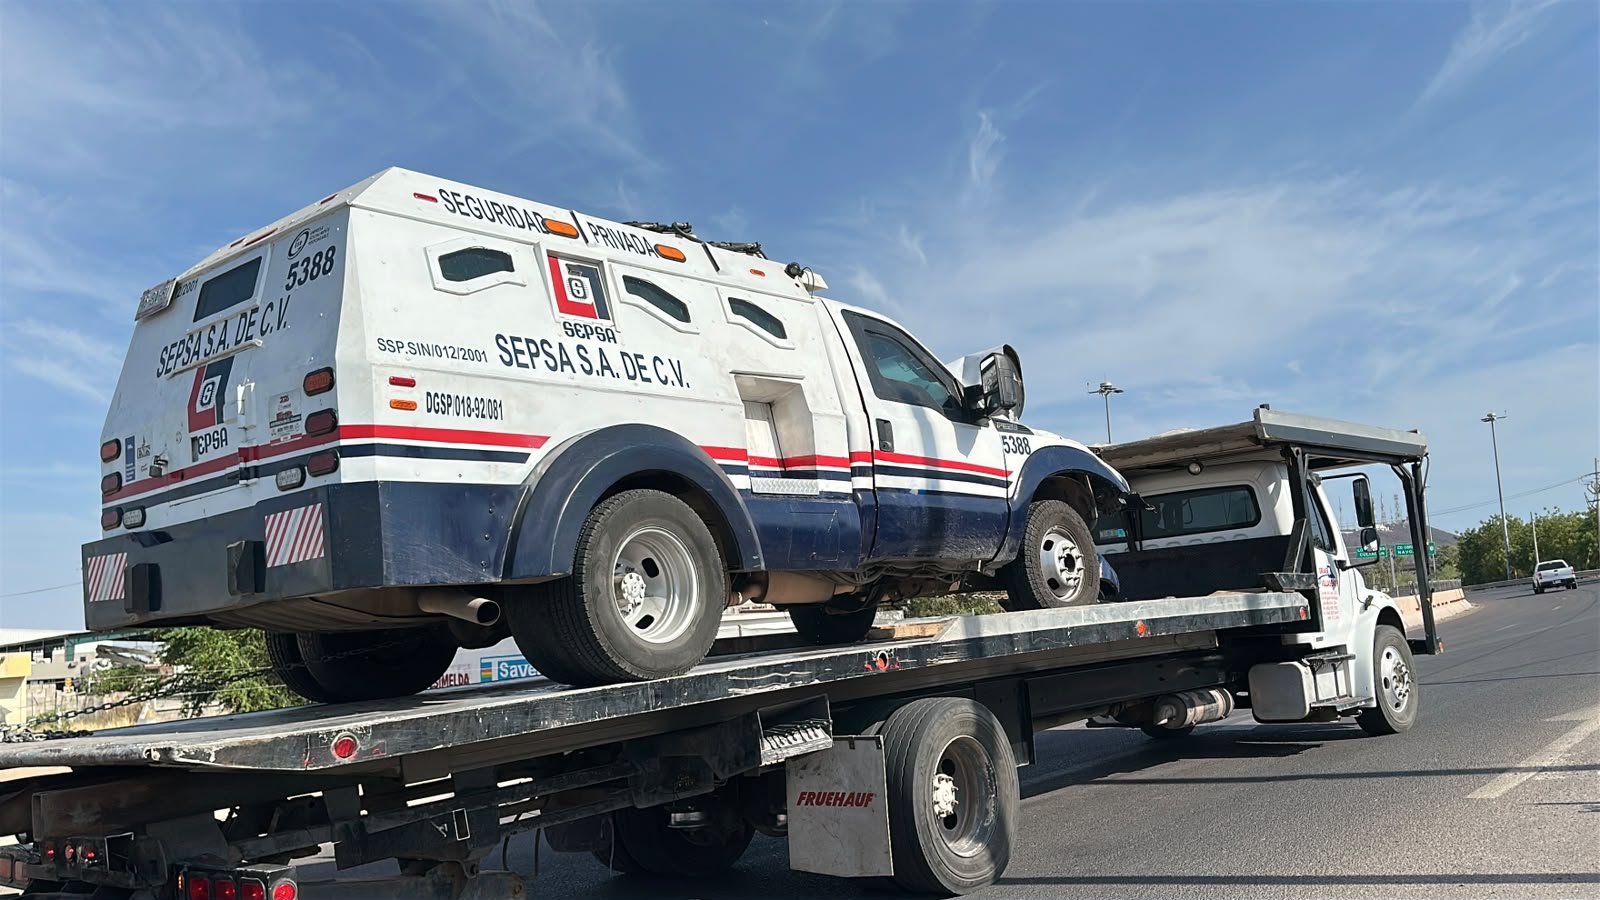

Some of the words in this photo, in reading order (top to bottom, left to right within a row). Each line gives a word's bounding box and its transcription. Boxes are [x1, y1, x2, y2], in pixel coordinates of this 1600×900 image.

[439, 188, 550, 235] SEGURIDAD
[587, 222, 660, 259] PRIVADA
[285, 245, 337, 292] 5388
[157, 331, 202, 378] SEPSA
[204, 320, 230, 358] S.A.
[234, 307, 260, 346] DE
[260, 294, 291, 337] C.V.
[562, 321, 618, 344] SEPSA
[376, 337, 488, 363] SSP.SIN/012/2001
[495, 333, 576, 374] SEPSA
[576, 344, 620, 379] S.A.
[620, 351, 652, 384] DE
[652, 355, 691, 389] C.V.
[426, 391, 504, 421] DGSP/018-92/081
[196, 427, 229, 456] EPSA
[1001, 435, 1032, 455] 5388
[796, 791, 875, 808] FRUEHAUF
